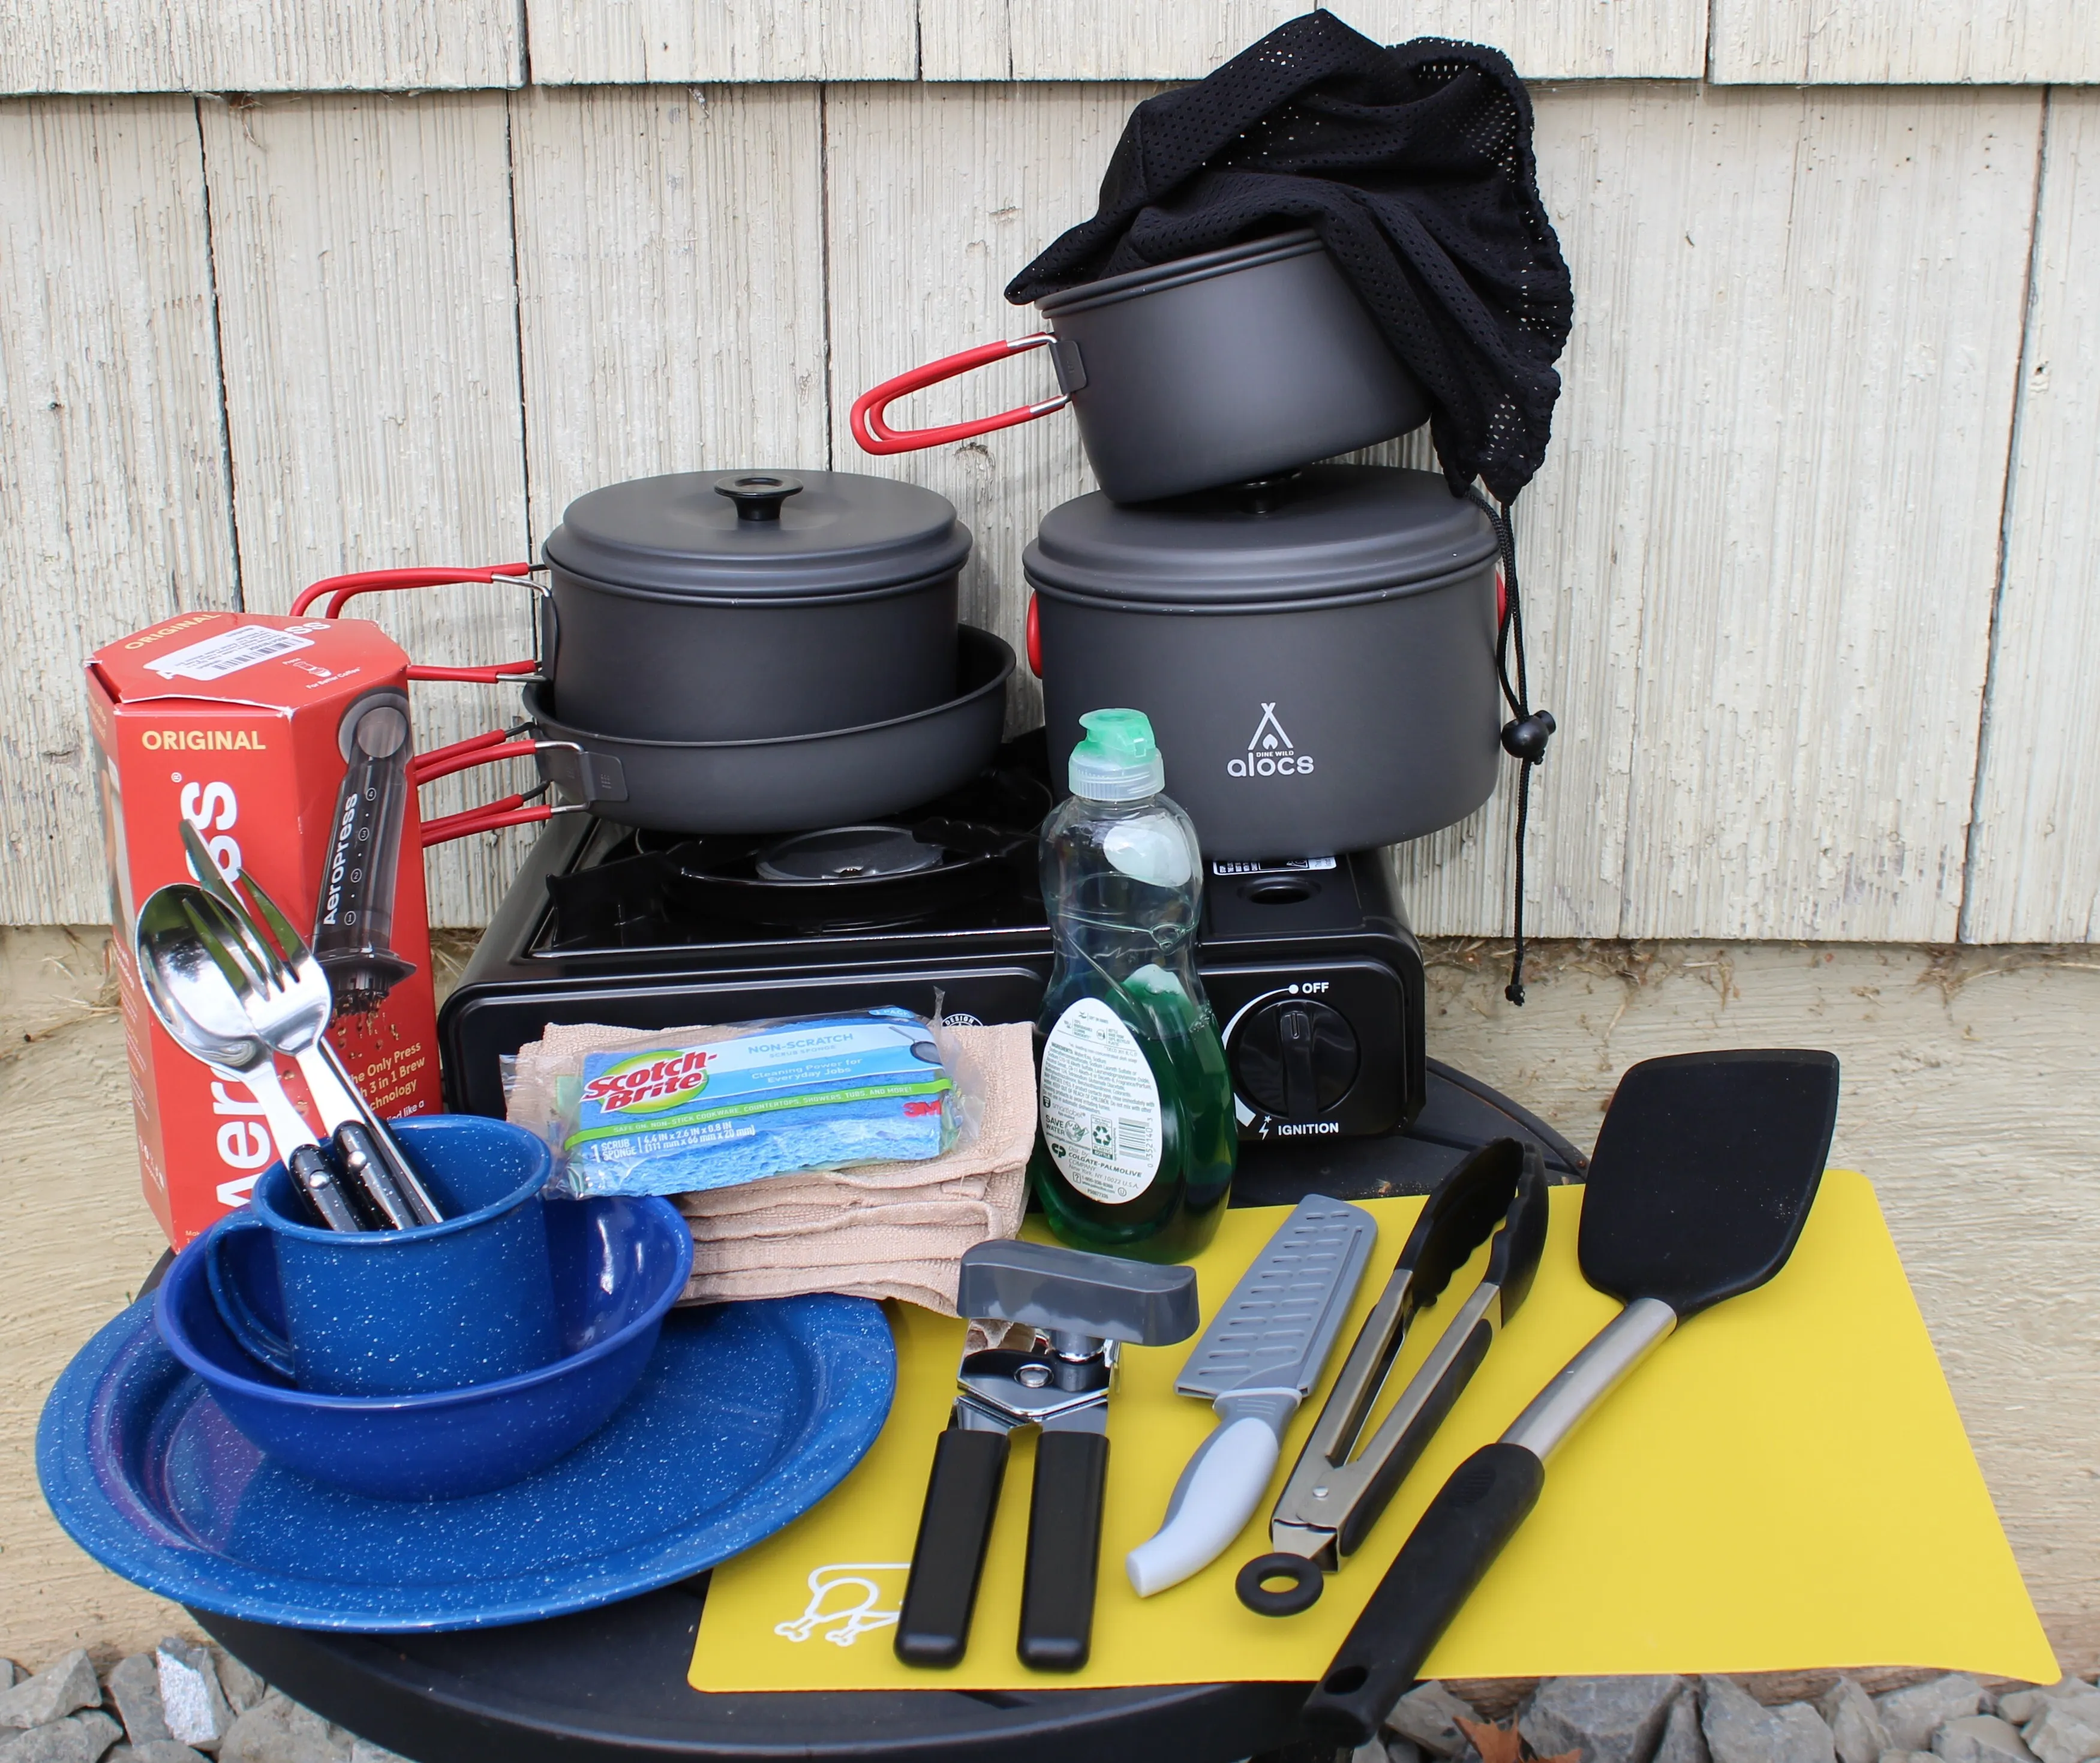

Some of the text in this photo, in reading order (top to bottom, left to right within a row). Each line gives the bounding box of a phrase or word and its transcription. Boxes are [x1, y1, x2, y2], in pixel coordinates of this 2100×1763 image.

[124, 614, 221, 650] ORIGINAL
[142, 730, 266, 750] ORIGINAL
[1227, 752, 1314, 777] alocs
[1302, 982, 1329, 994] OFF
[945, 1015, 975, 1026] DESIGN
[748, 1033, 854, 1054] NON-SCRATCH
[801, 1045, 836, 1054] SPONGE
[349, 1042, 421, 1084] he Only Press
[752, 1067, 803, 1079] Cleaning
[806, 1061, 842, 1071] Power
[369, 1081, 377, 1094] 3
[378, 1077, 389, 1089] in
[391, 1070, 397, 1083] 1
[399, 1057, 425, 1078] Brew
[768, 1067, 852, 1083] Everyday Jobs
[369, 1079, 417, 1111] chnology
[605, 1073, 702, 1111] Brite
[403, 1104, 417, 1118] like
[419, 1100, 425, 1109] a
[613, 1125, 634, 1134] SAFE
[650, 1115, 695, 1128] NON-STICK
[887, 1086, 913, 1094] MORE!
[903, 1100, 942, 1118] 3M
[1046, 1114, 1064, 1129] SAVE
[1046, 1122, 1065, 1136] WATER
[1278, 1122, 1339, 1136] IGNITION
[644, 1133, 657, 1144] 4.4
[659, 1133, 668, 1142] IN
[676, 1128, 690, 1139] 2.6
[690, 1127, 701, 1137] IN
[708, 1124, 722, 1133] 0.8
[722, 1121, 732, 1131] IN
[663, 1140, 680, 1149] mm
[687, 1134, 699, 1144] 66
[700, 1133, 716, 1143] mm
[724, 1128, 735, 1139] 20
[590, 1144, 600, 1163] 1
[601, 1139, 630, 1151] SCRUB
[602, 1147, 636, 1161] SPONGE
[1081, 1149, 1089, 1158] by
[1068, 1158, 1096, 1172] COMPANY
[1104, 1175, 1121, 1185] 10022
